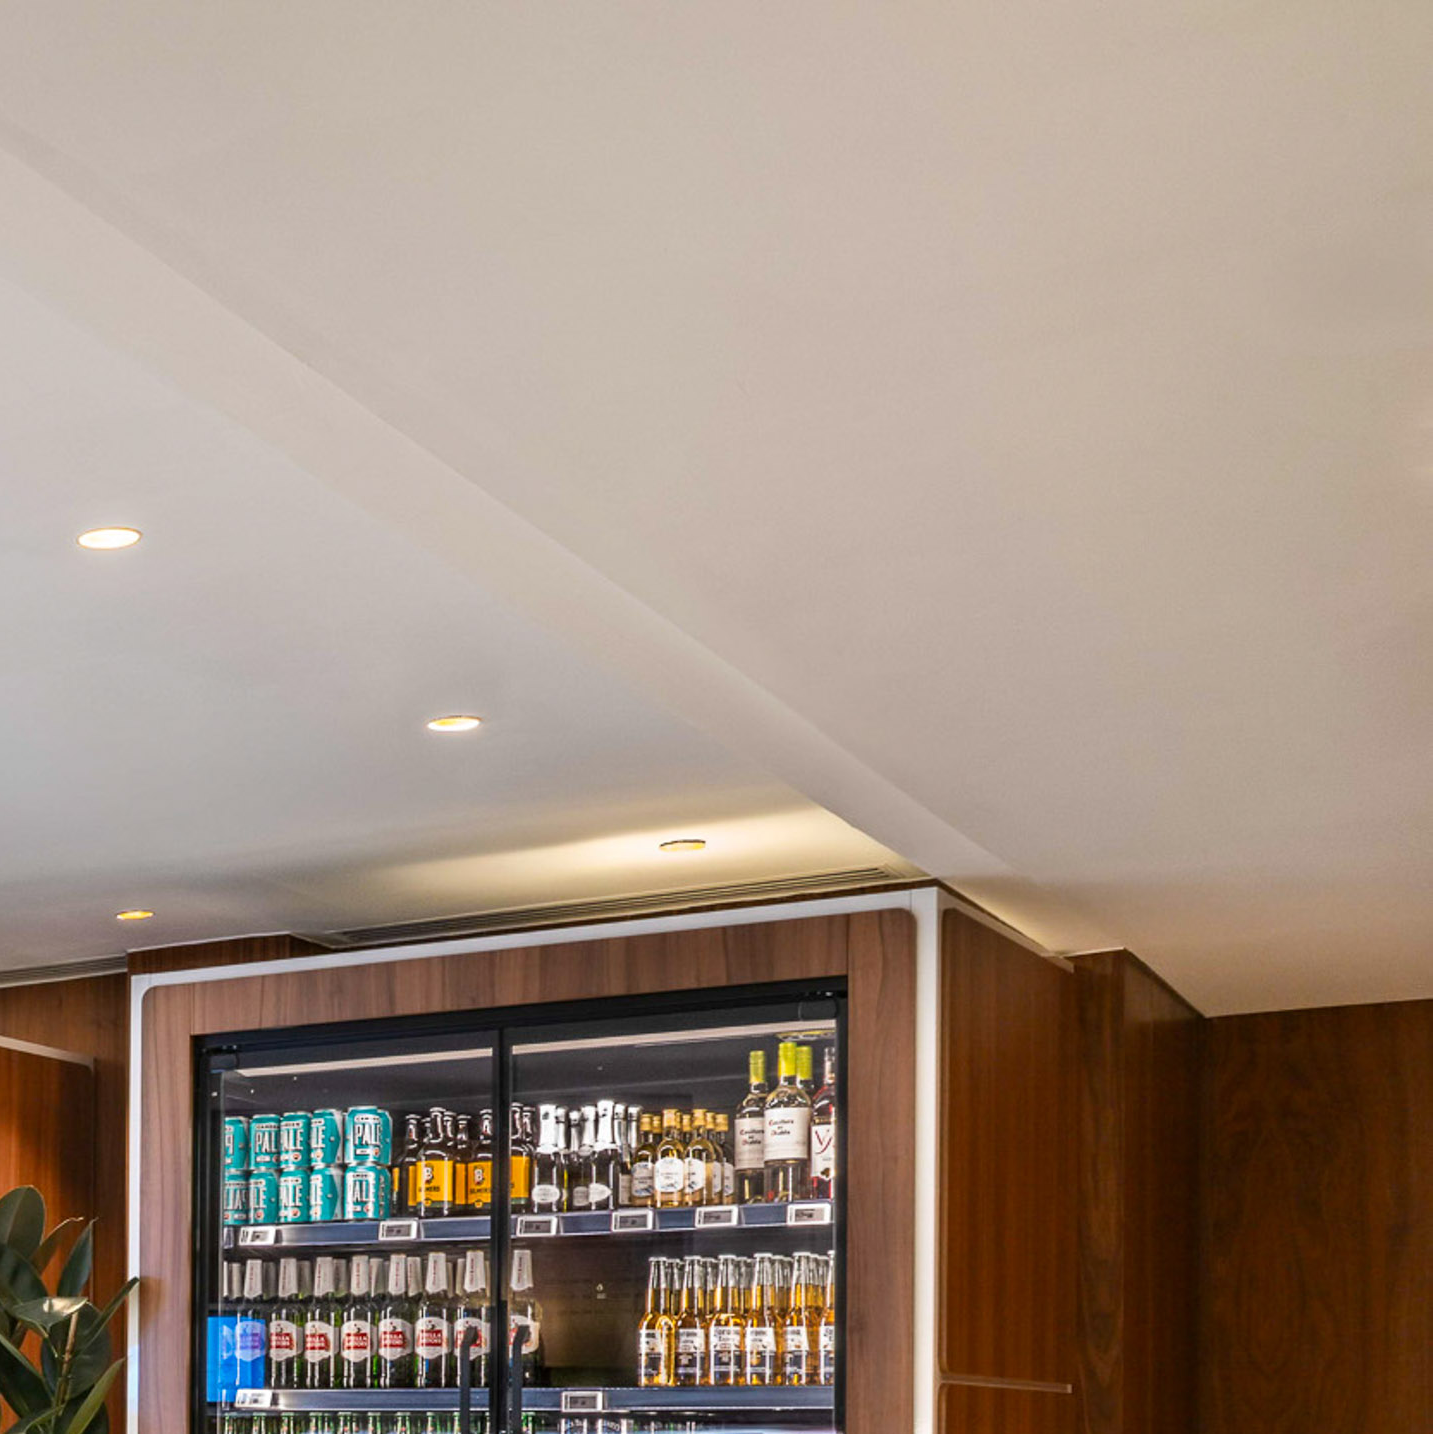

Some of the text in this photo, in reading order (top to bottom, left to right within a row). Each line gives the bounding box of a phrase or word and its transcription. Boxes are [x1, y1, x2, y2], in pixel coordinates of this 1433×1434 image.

[255, 1131, 278, 1154] PAL
[281, 1128, 304, 1151] ALE
[355, 1123, 382, 1147] PALE
[282, 1185, 303, 1207] ALE
[353, 1180, 376, 1203] ALE
